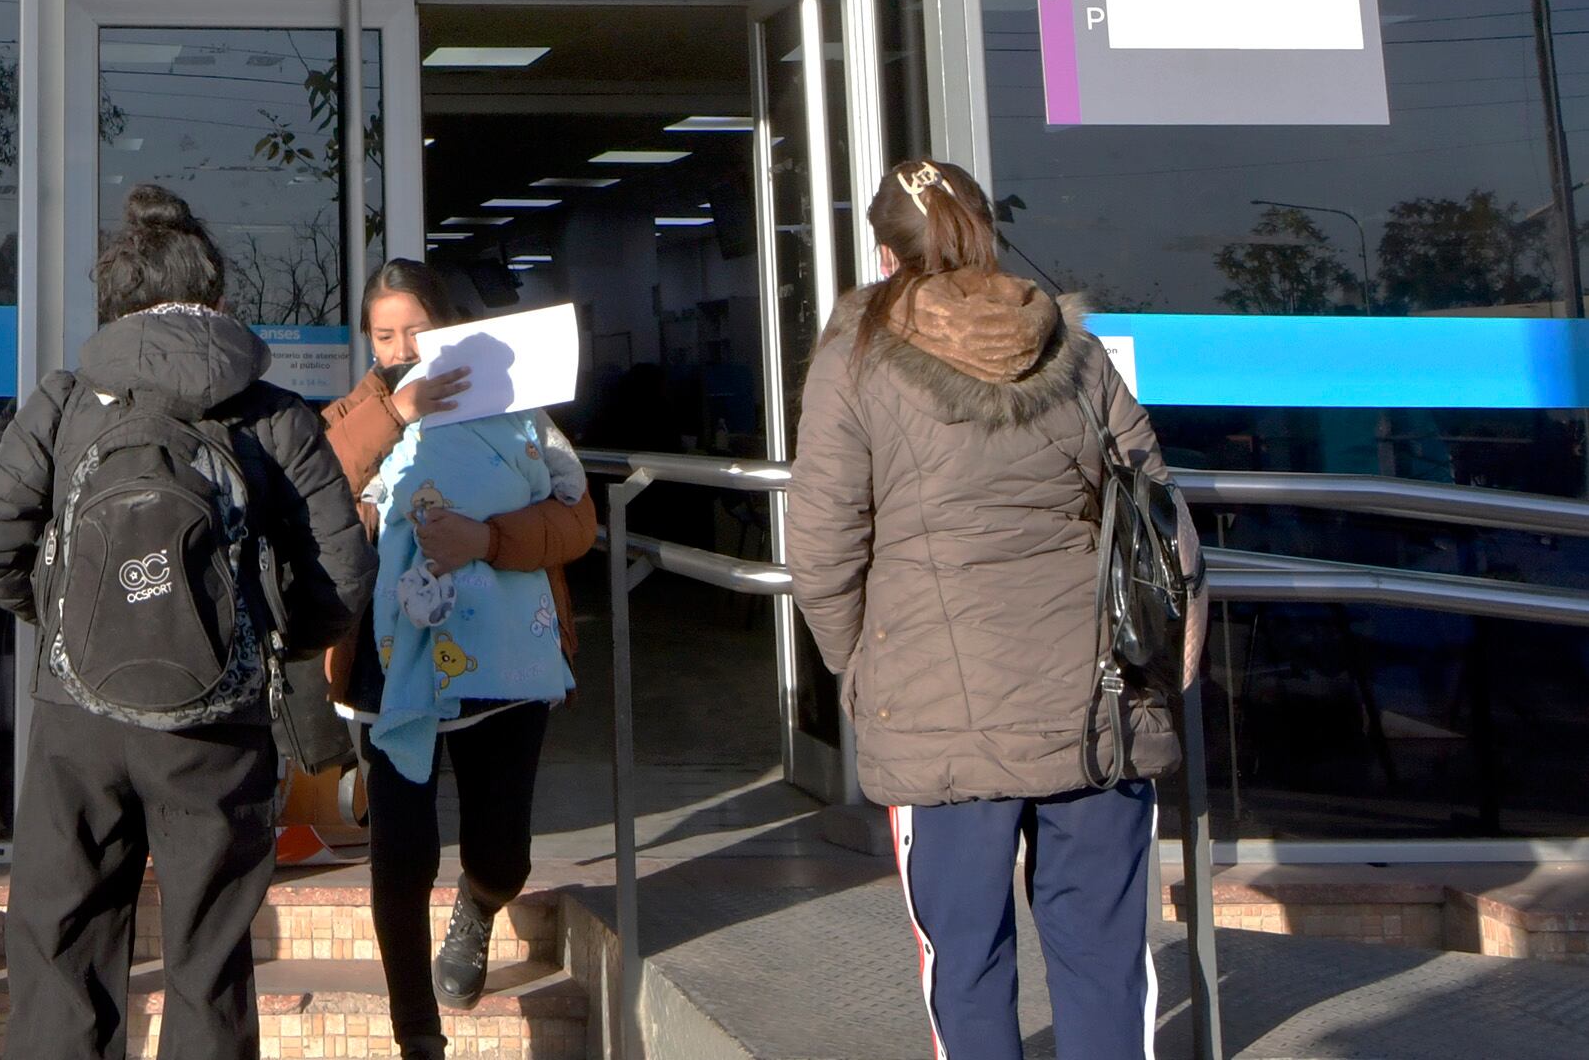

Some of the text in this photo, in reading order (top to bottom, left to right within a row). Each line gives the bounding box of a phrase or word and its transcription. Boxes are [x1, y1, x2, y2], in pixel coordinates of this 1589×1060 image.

[260, 328, 300, 340] anses
[302, 351, 312, 359] de
[290, 361, 331, 370] al público
[126, 581, 172, 603] OCSPORT
